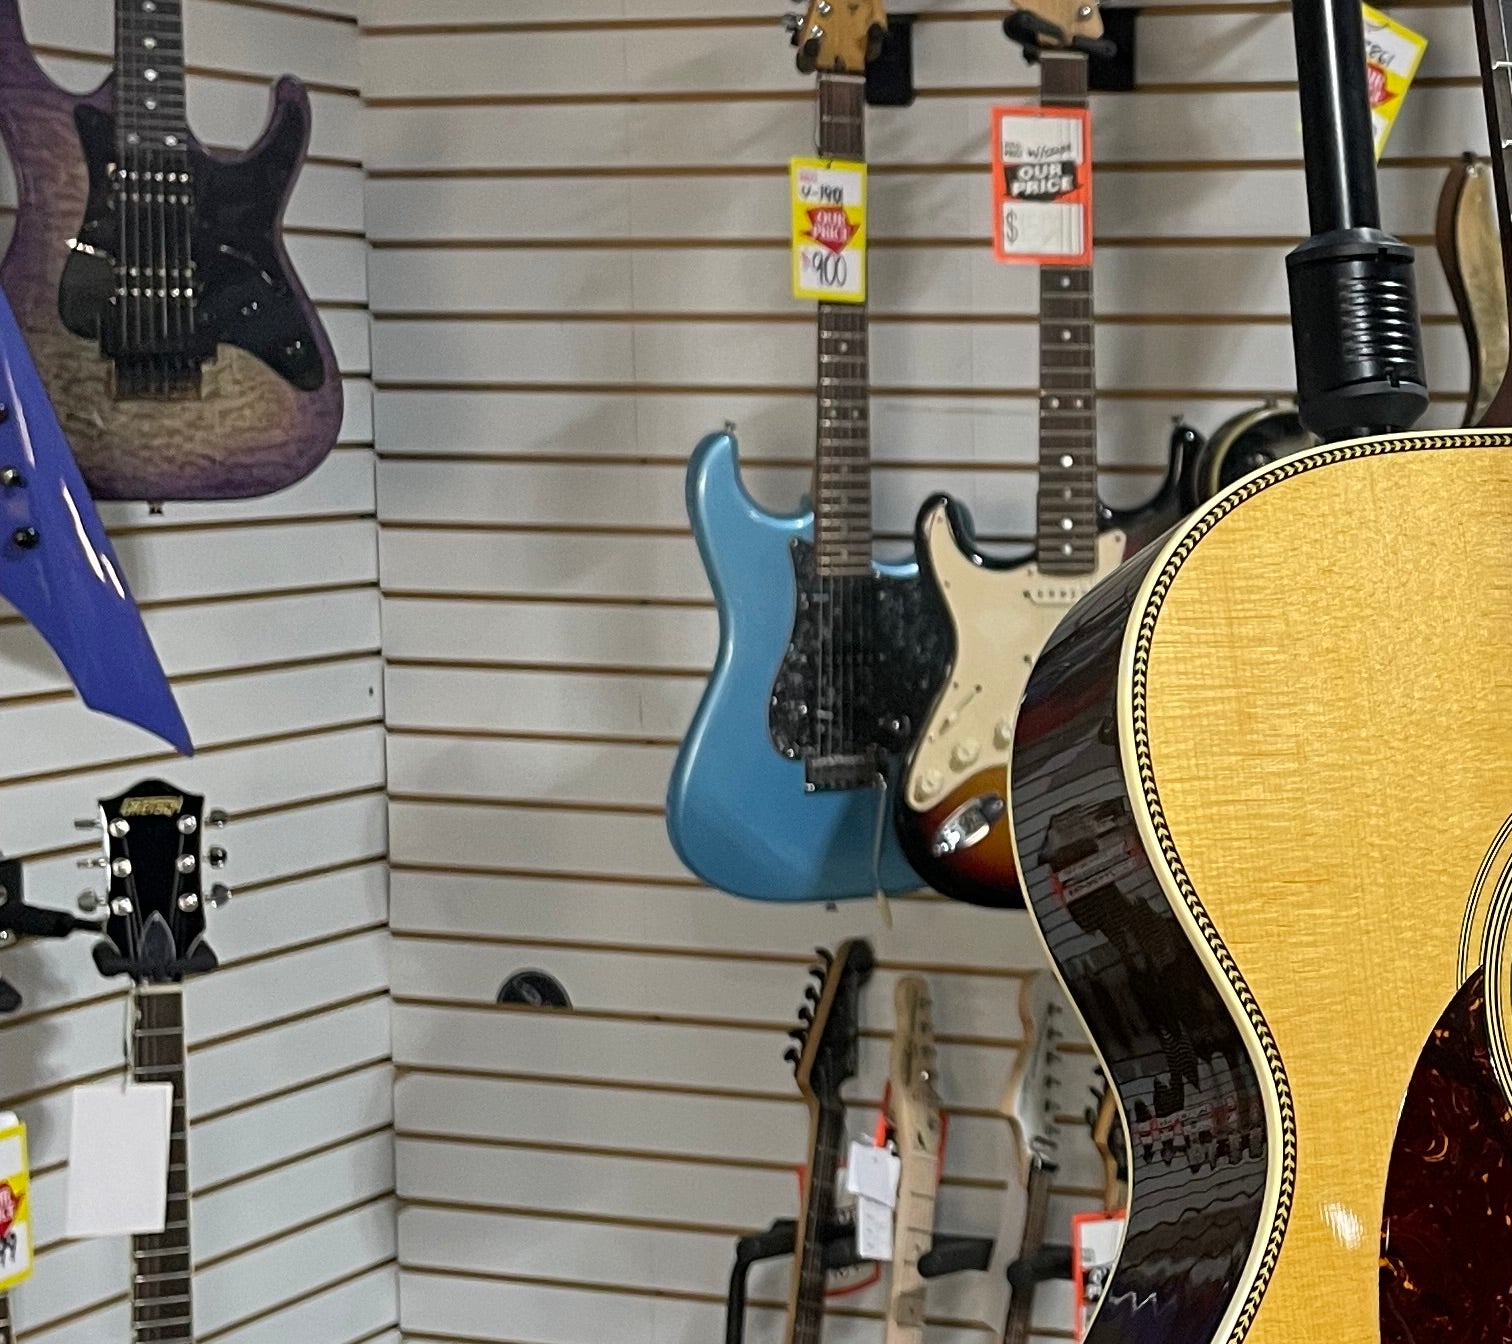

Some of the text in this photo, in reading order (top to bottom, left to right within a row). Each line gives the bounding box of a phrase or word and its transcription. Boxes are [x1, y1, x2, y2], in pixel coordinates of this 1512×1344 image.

[1018, 162, 1063, 181] OUR
[1011, 175, 1075, 196] PRICE
[816, 208, 847, 226] OUR
